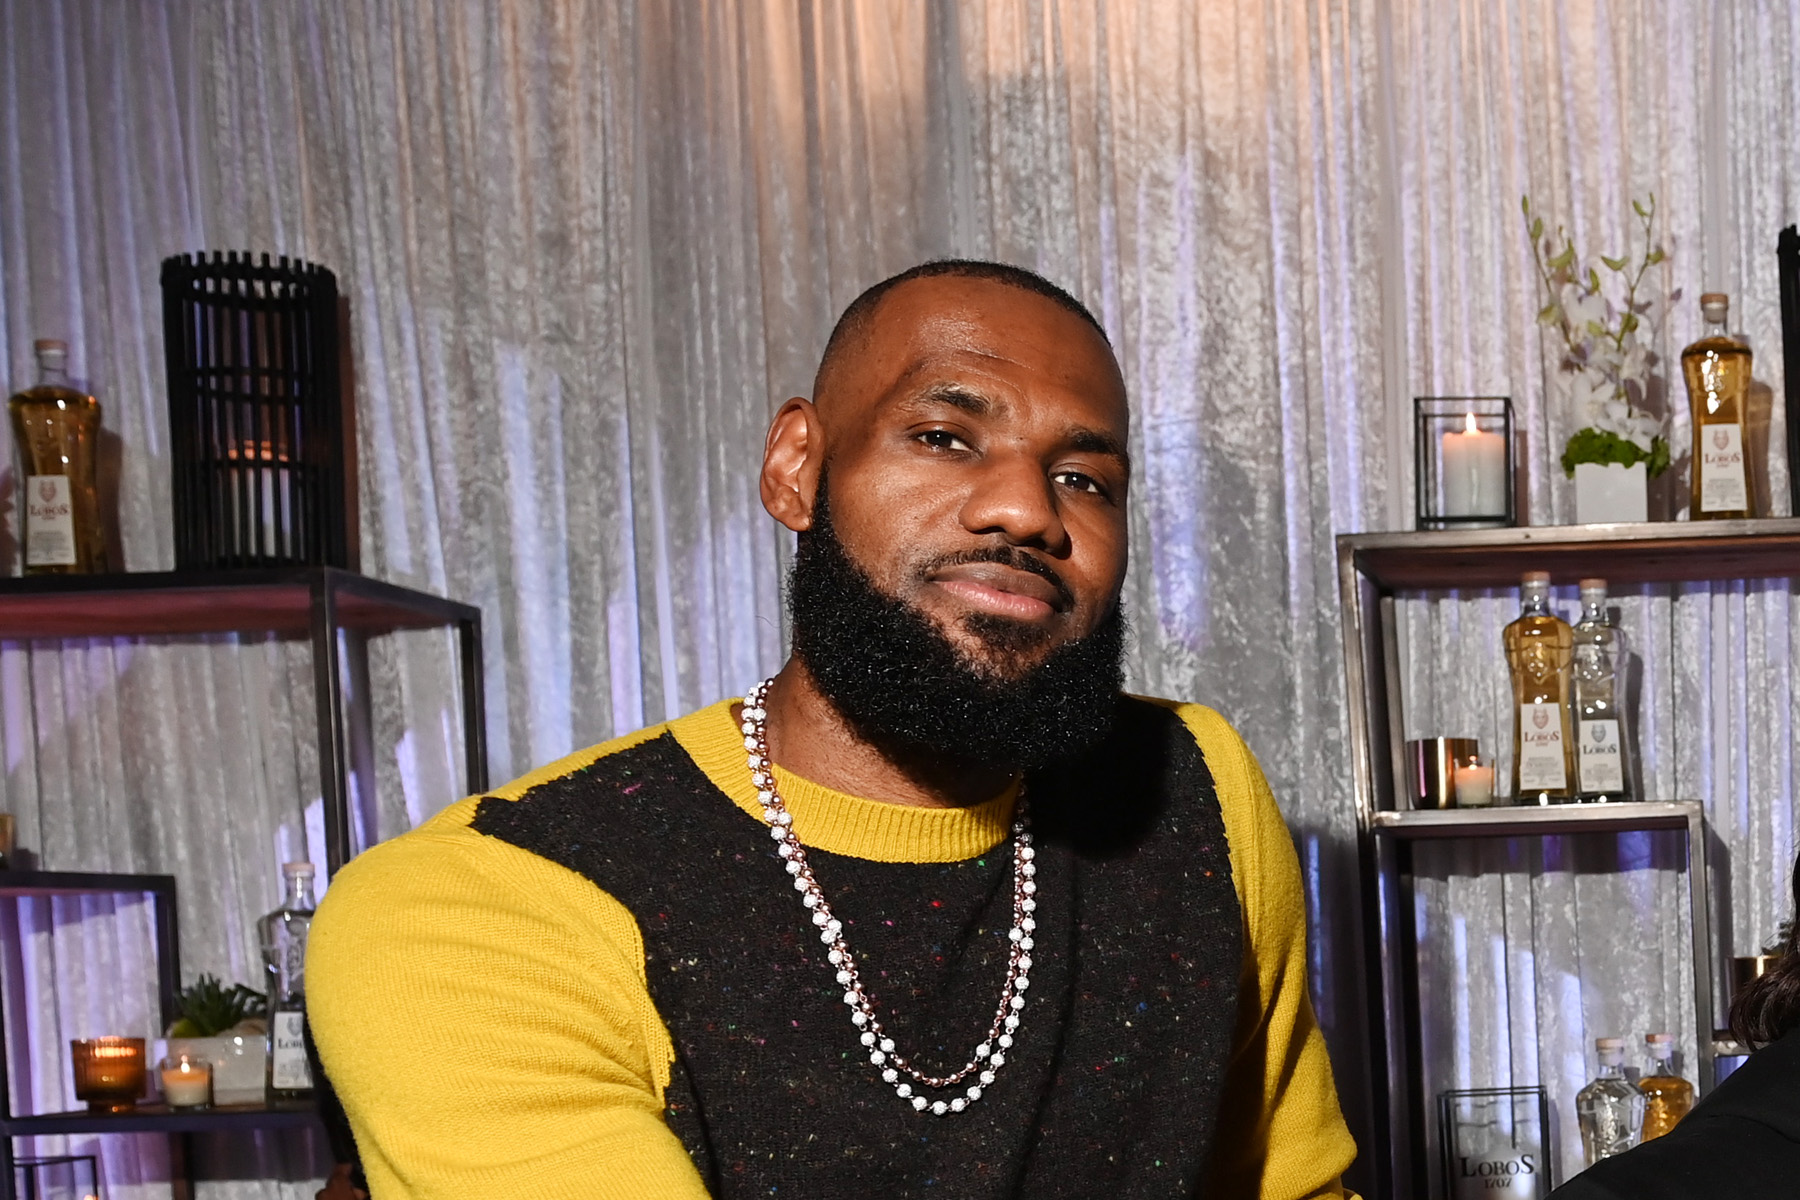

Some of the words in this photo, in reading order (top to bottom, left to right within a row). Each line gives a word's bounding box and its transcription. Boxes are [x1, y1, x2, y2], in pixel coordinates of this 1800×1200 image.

[1524, 731, 1559, 742] LOBOS
[1583, 744, 1616, 754] LOBOS
[1460, 1154, 1534, 1177] LOBOS
[1484, 1178, 1512, 1189] 1707
